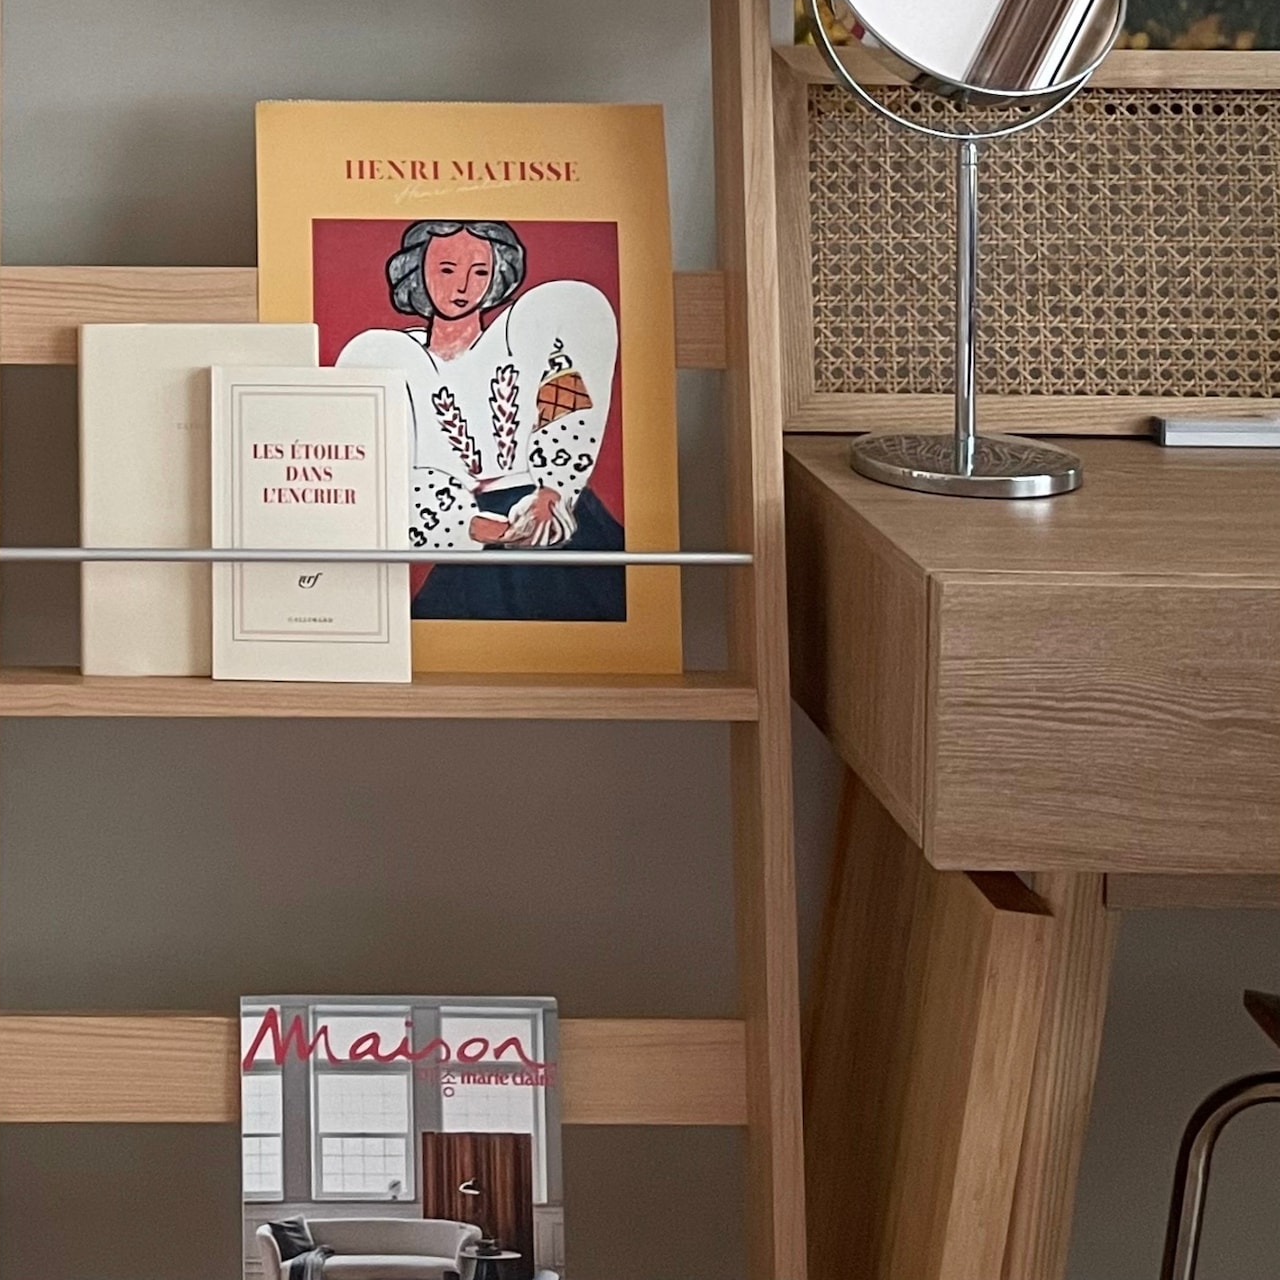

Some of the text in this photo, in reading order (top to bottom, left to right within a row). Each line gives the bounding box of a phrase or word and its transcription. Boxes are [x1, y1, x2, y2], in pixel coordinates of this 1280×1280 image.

[345, 159, 581, 182] HENRI MATISSE
[253, 439, 366, 460] LES ÉTOILES
[286, 466, 333, 481] DANS
[263, 488, 356, 504] L'ENCRIER
[242, 1007, 556, 1070] Maison
[461, 1071, 509, 1086] marie
